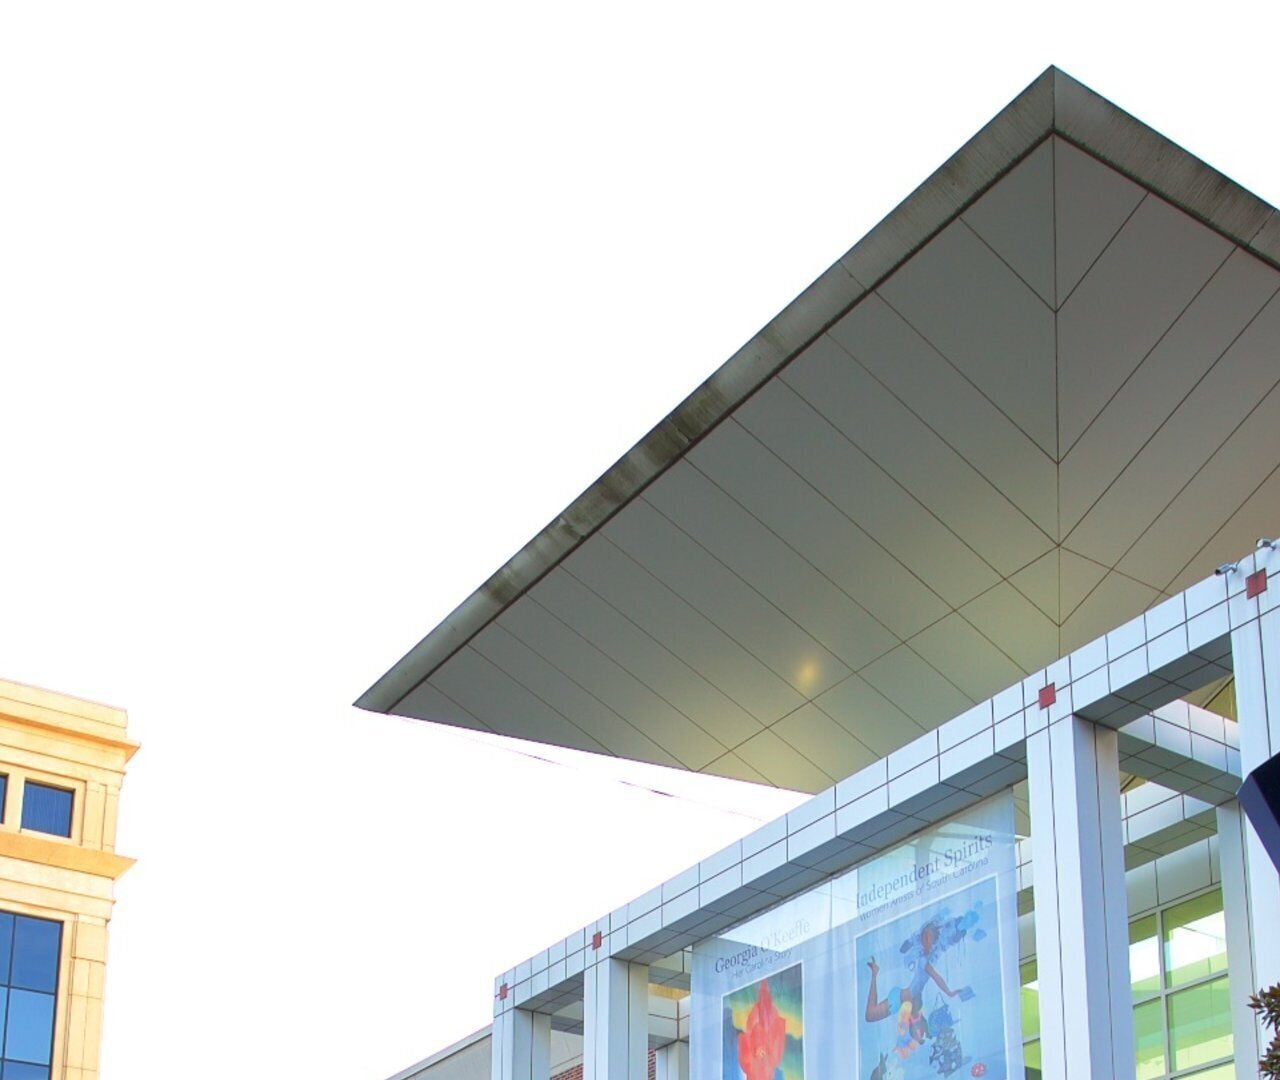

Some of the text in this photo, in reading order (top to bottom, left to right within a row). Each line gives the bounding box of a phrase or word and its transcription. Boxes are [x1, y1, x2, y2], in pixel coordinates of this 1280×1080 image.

[857, 834, 993, 908] Independent Spirits
[859, 903, 889, 922] Women
[953, 856, 989, 879] Carolina
[715, 945, 758, 973] Georgia
